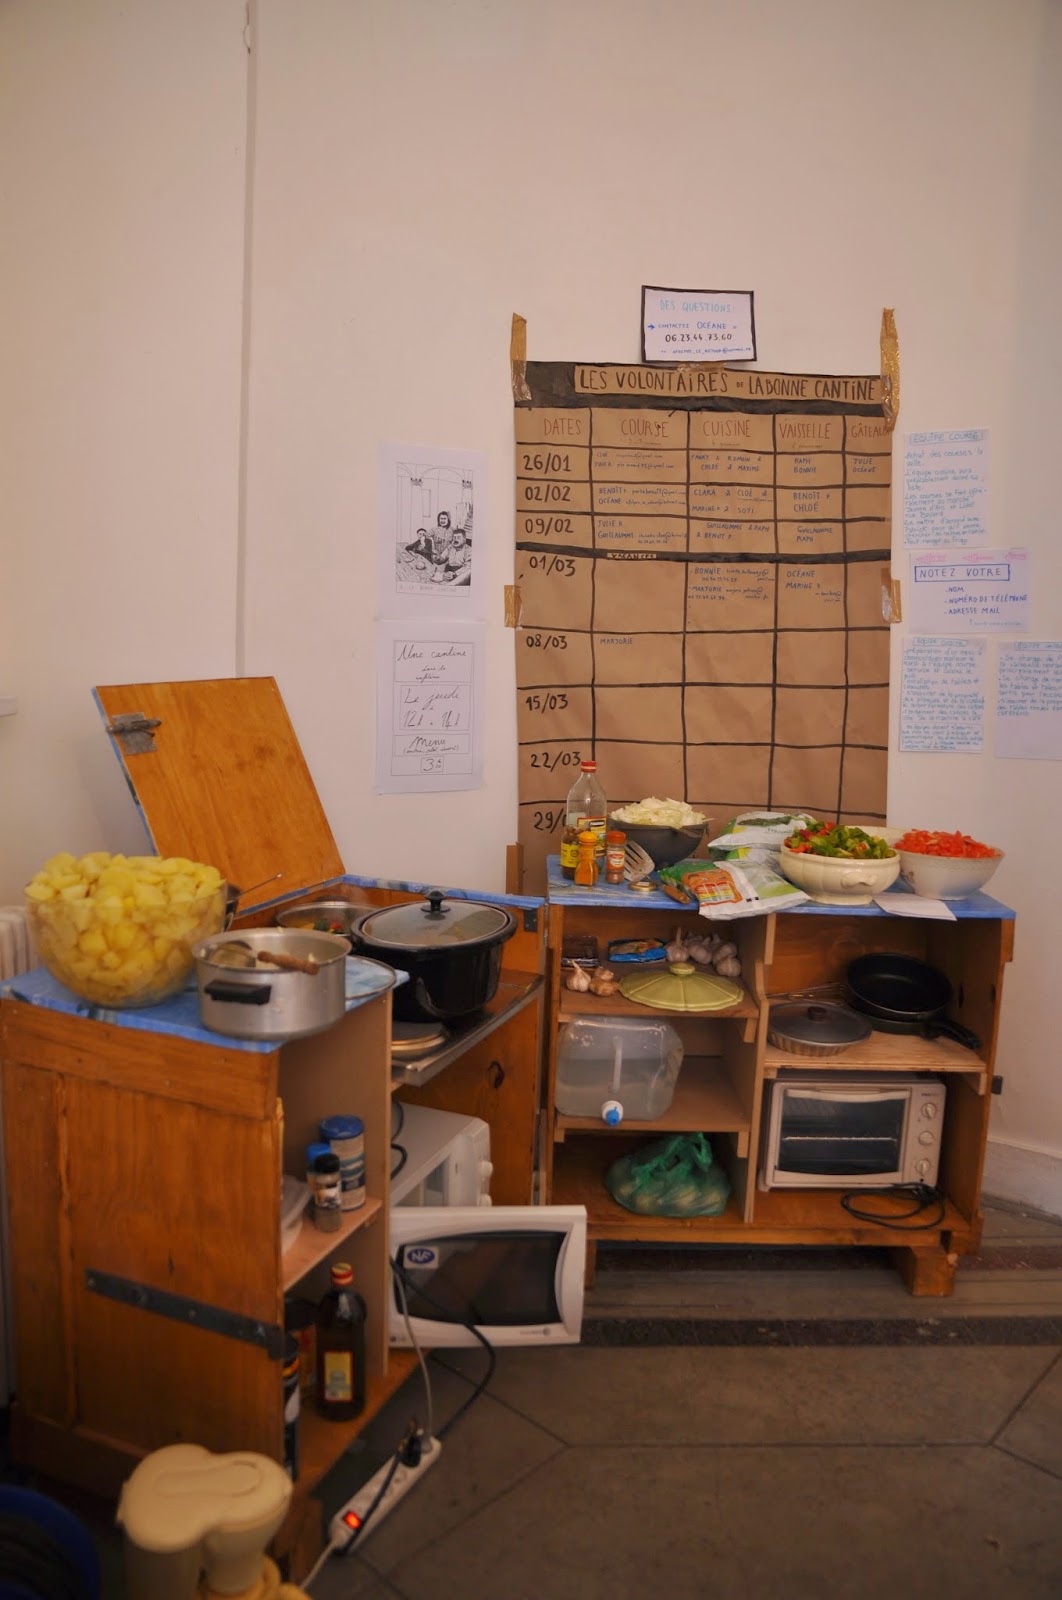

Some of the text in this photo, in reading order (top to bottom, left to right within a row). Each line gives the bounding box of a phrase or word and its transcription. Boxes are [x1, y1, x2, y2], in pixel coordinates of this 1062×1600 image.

[660, 300, 675, 310] DES
[696, 321, 726, 330] OCÉANE
[580, 369, 607, 390] LES
[544, 418, 582, 436] DATES
[621, 419, 669, 438] COURSE
[948, 431, 979, 440] COURSE
[523, 453, 572, 474] 26/01
[525, 484, 571, 502] 02/02
[793, 491, 820, 500] BENOÎT
[794, 502, 819, 512] CHLOÉ
[525, 518, 574, 536] 09/02
[530, 556, 576, 576] 01/03
[694, 566, 721, 574] BONNIE
[786, 568, 816, 578] OCÉANE
[920, 568, 1001, 578] NOTEZ VOTRE
[786, 582, 812, 590] MARINE
[526, 634, 568, 650] 08/03
[398, 644, 466, 661] Une cantine
[404, 688, 420, 704] Le
[526, 692, 568, 714] 15/03
[530, 751, 580, 772] 22/03
[411, 1251, 433, 1262] NF
